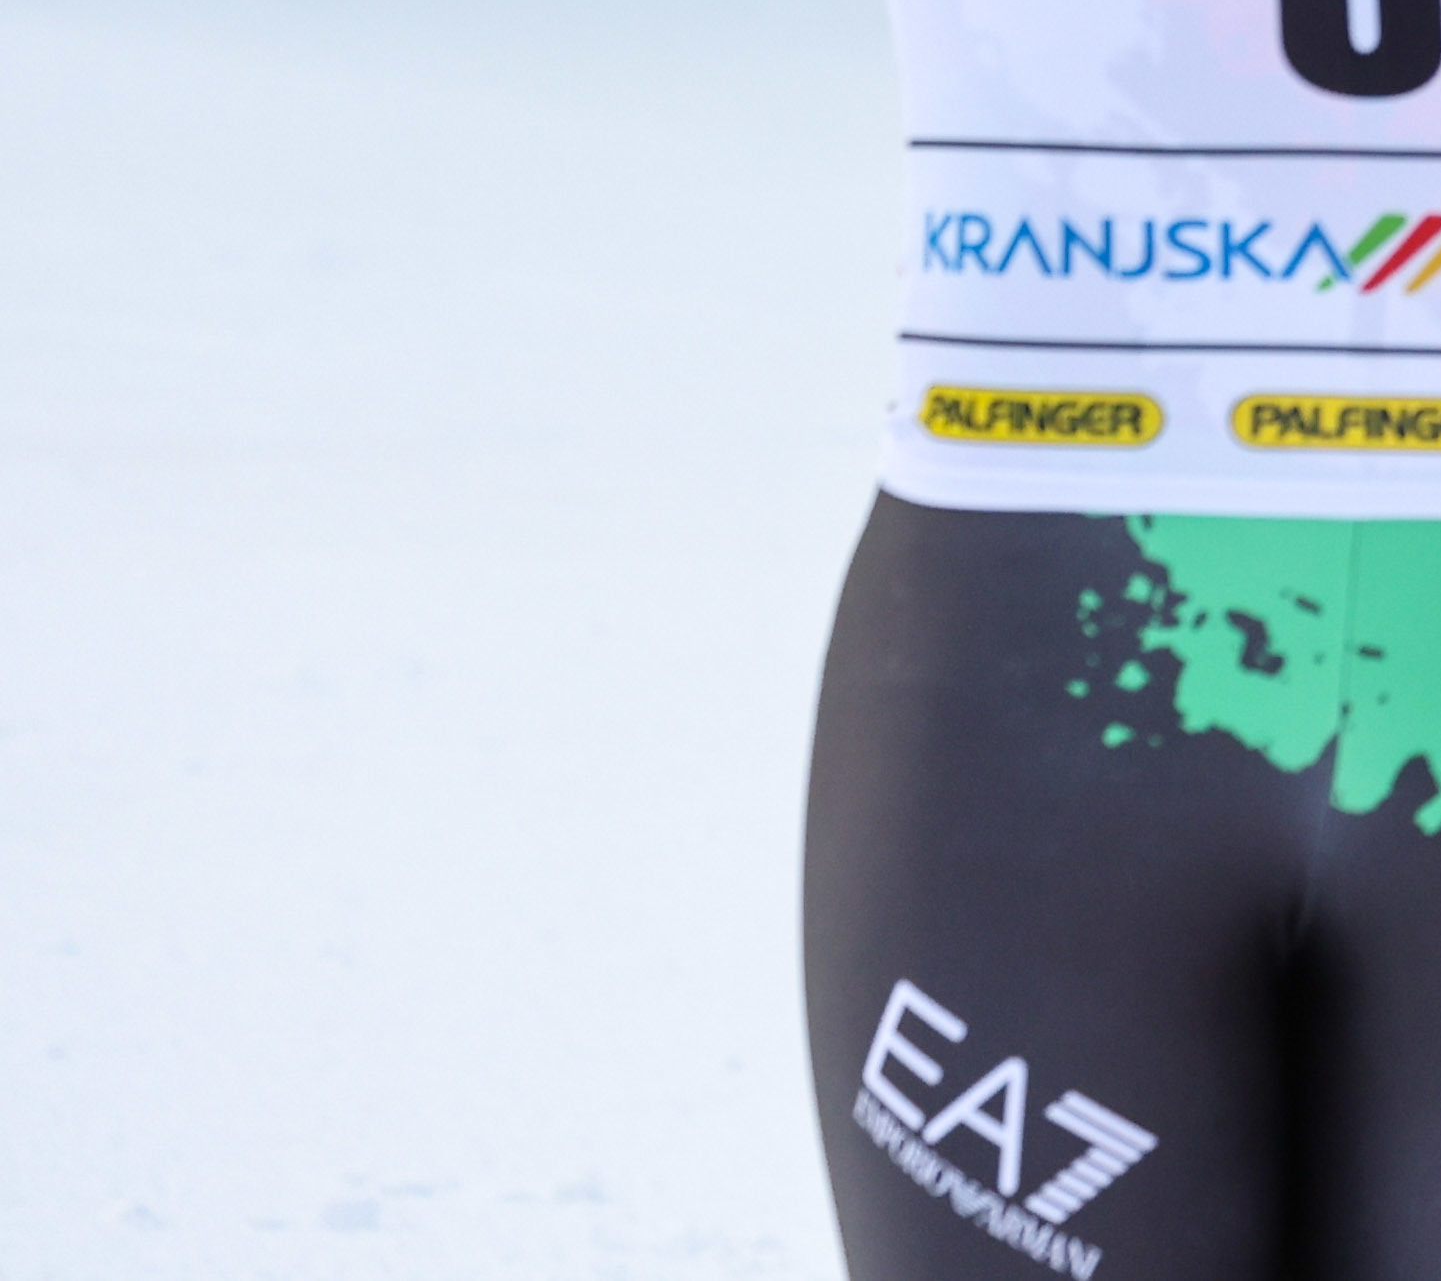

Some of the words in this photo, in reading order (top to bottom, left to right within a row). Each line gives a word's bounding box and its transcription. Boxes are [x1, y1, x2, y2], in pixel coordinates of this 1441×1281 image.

[922, 211, 1351, 284] KRANJSKA
[924, 393, 1144, 437] PALFINGER
[861, 977, 1160, 1226] EA7
